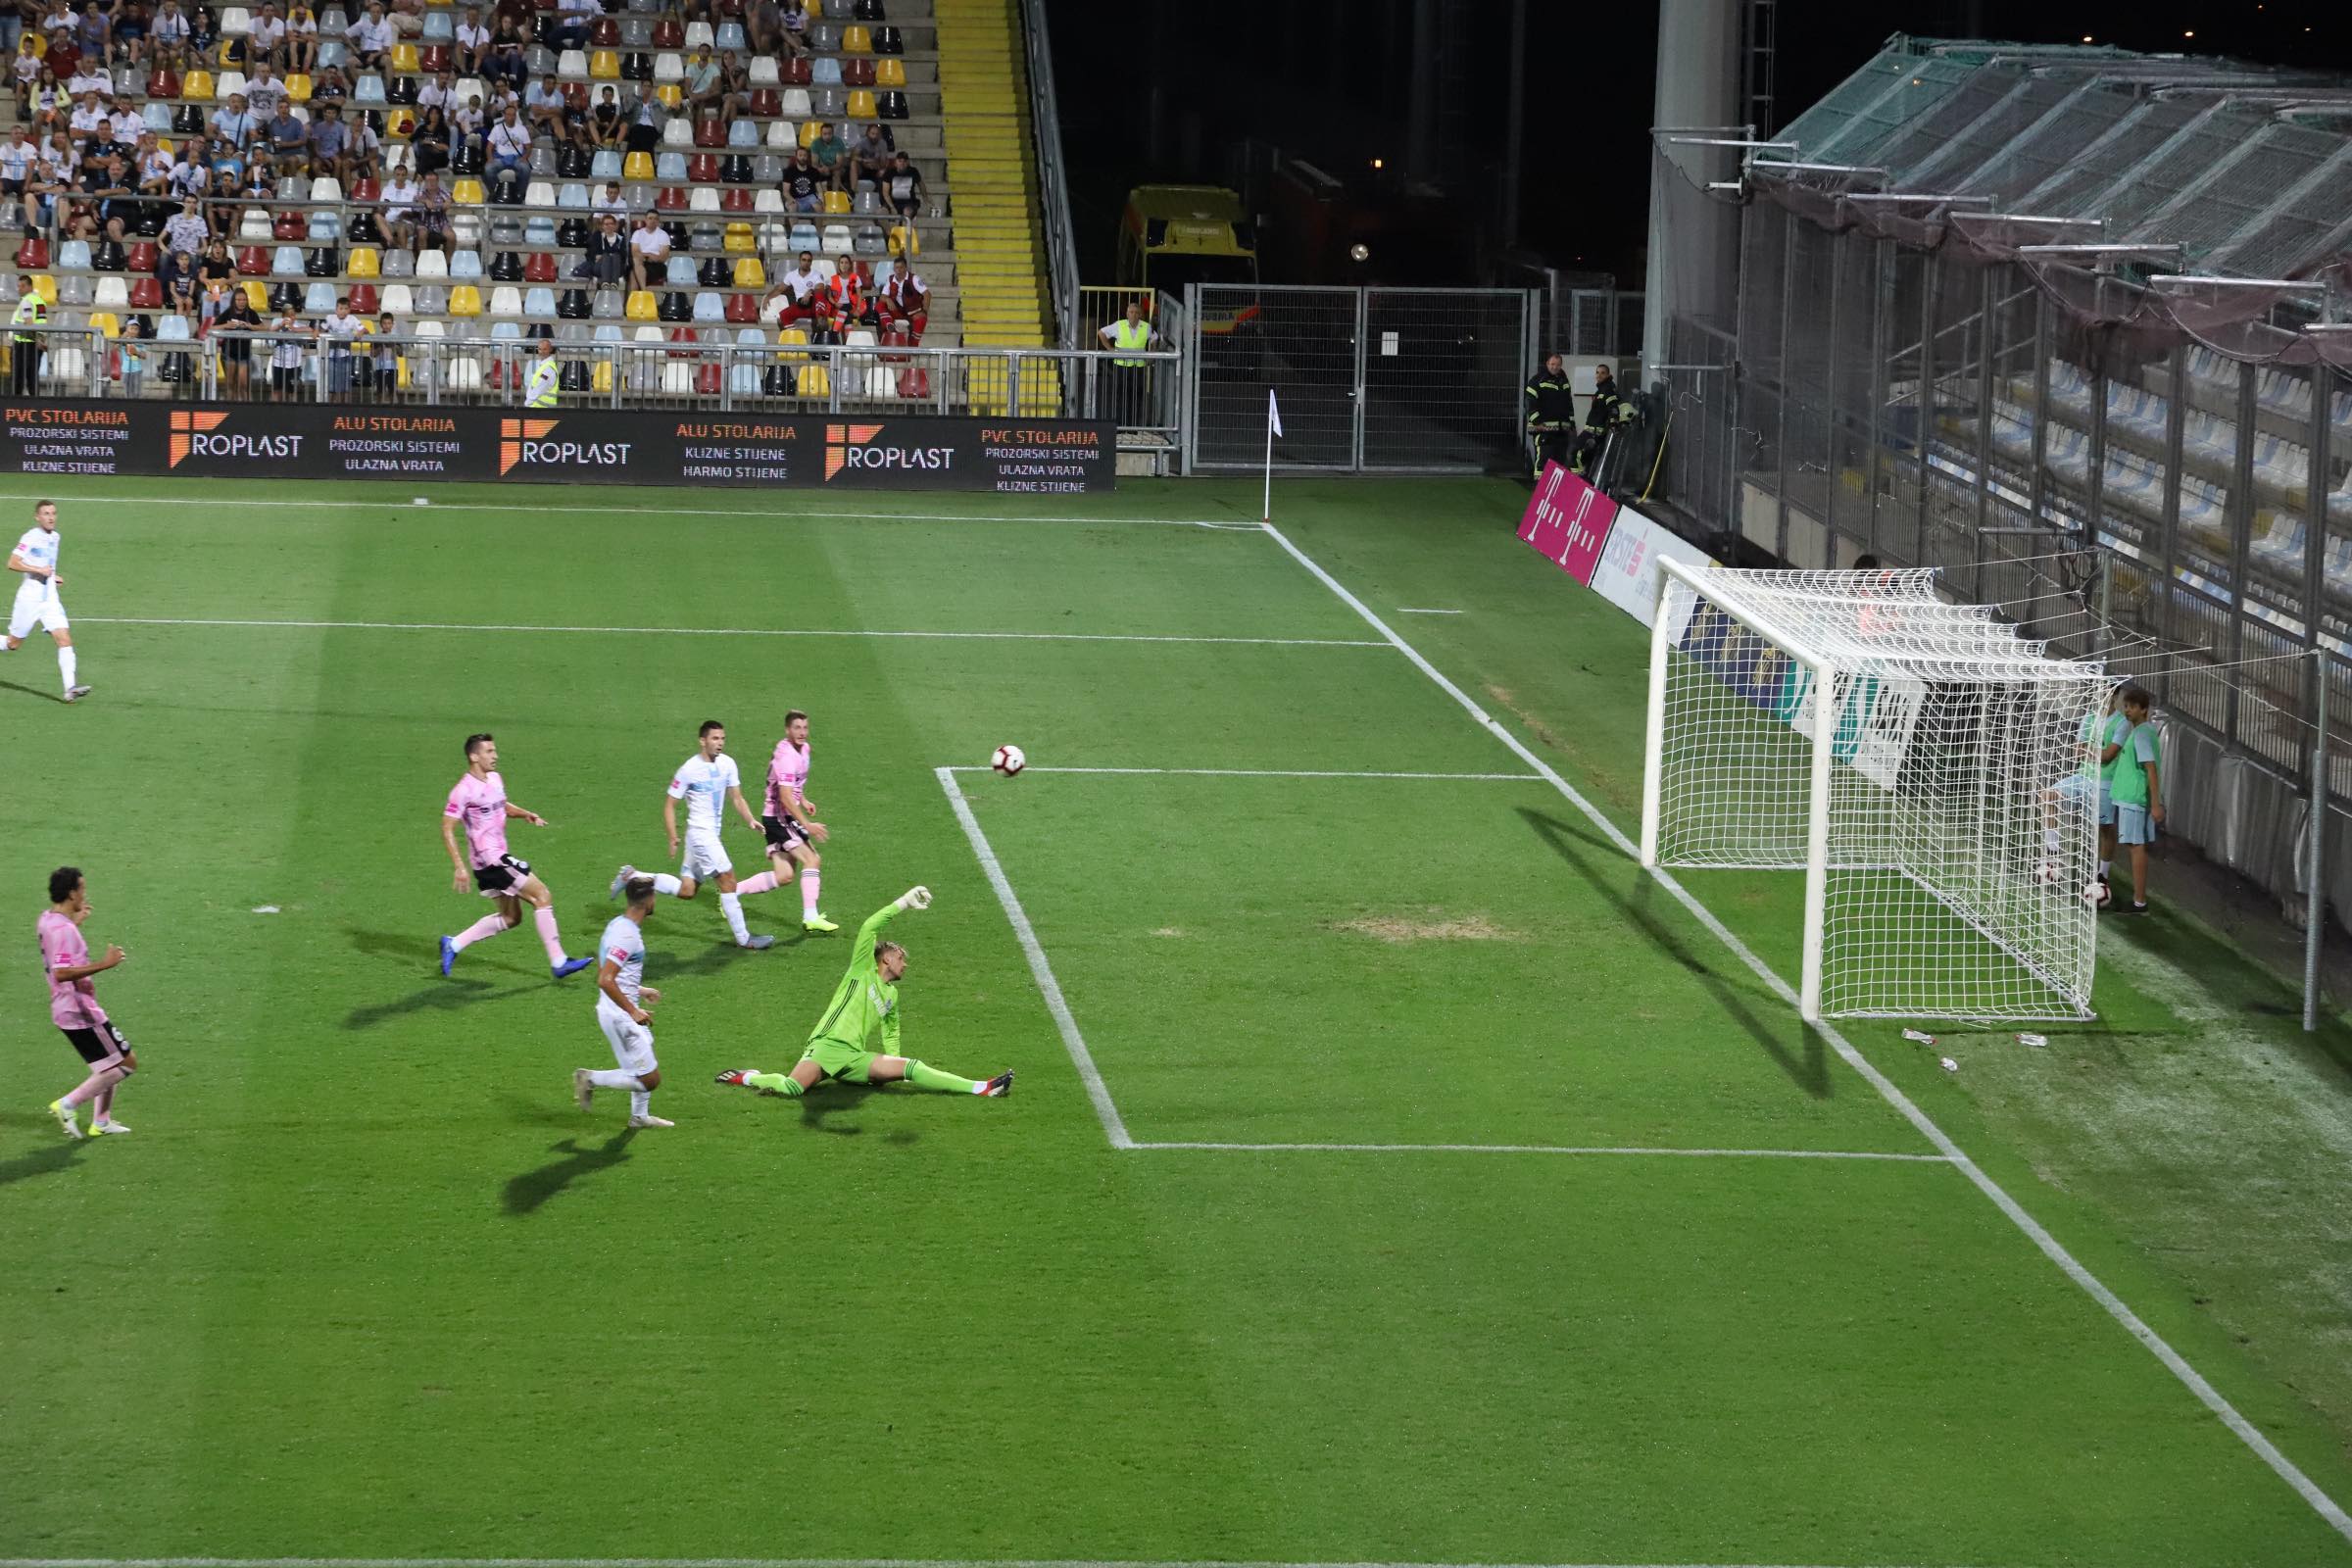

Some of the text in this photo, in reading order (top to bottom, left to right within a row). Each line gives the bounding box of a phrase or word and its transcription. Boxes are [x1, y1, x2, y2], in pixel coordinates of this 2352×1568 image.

[6, 410, 127, 424] PVC STOLARIJA
[335, 417, 455, 431] ALU STOLARIJA
[10, 427, 128, 439] PROZORSKI SISTEMI
[677, 424, 795, 439] ALU STOLARIJA
[982, 430, 1098, 444] PVC STOLARIJA
[24, 445, 114, 456] ULAZNA VRATA
[193, 434, 303, 457] ROPLAST
[330, 440, 459, 453] PROZORSKI SISTEMI
[523, 442, 630, 464] ROPLAST
[686, 447, 784, 460] KLIZNE STIJENE
[849, 447, 954, 468] ROPLAST
[986, 448, 1099, 460] PROZORSKI SISTEMI
[23, 462, 115, 473] KLIZNE STIJENE
[346, 460, 444, 470] ULAZNA VRATA
[1000, 466, 1085, 475] ULAZNA VRATA
[684, 466, 786, 478] HARMO STIJENE
[997, 481, 1085, 492] KLIZNE STIJENE
